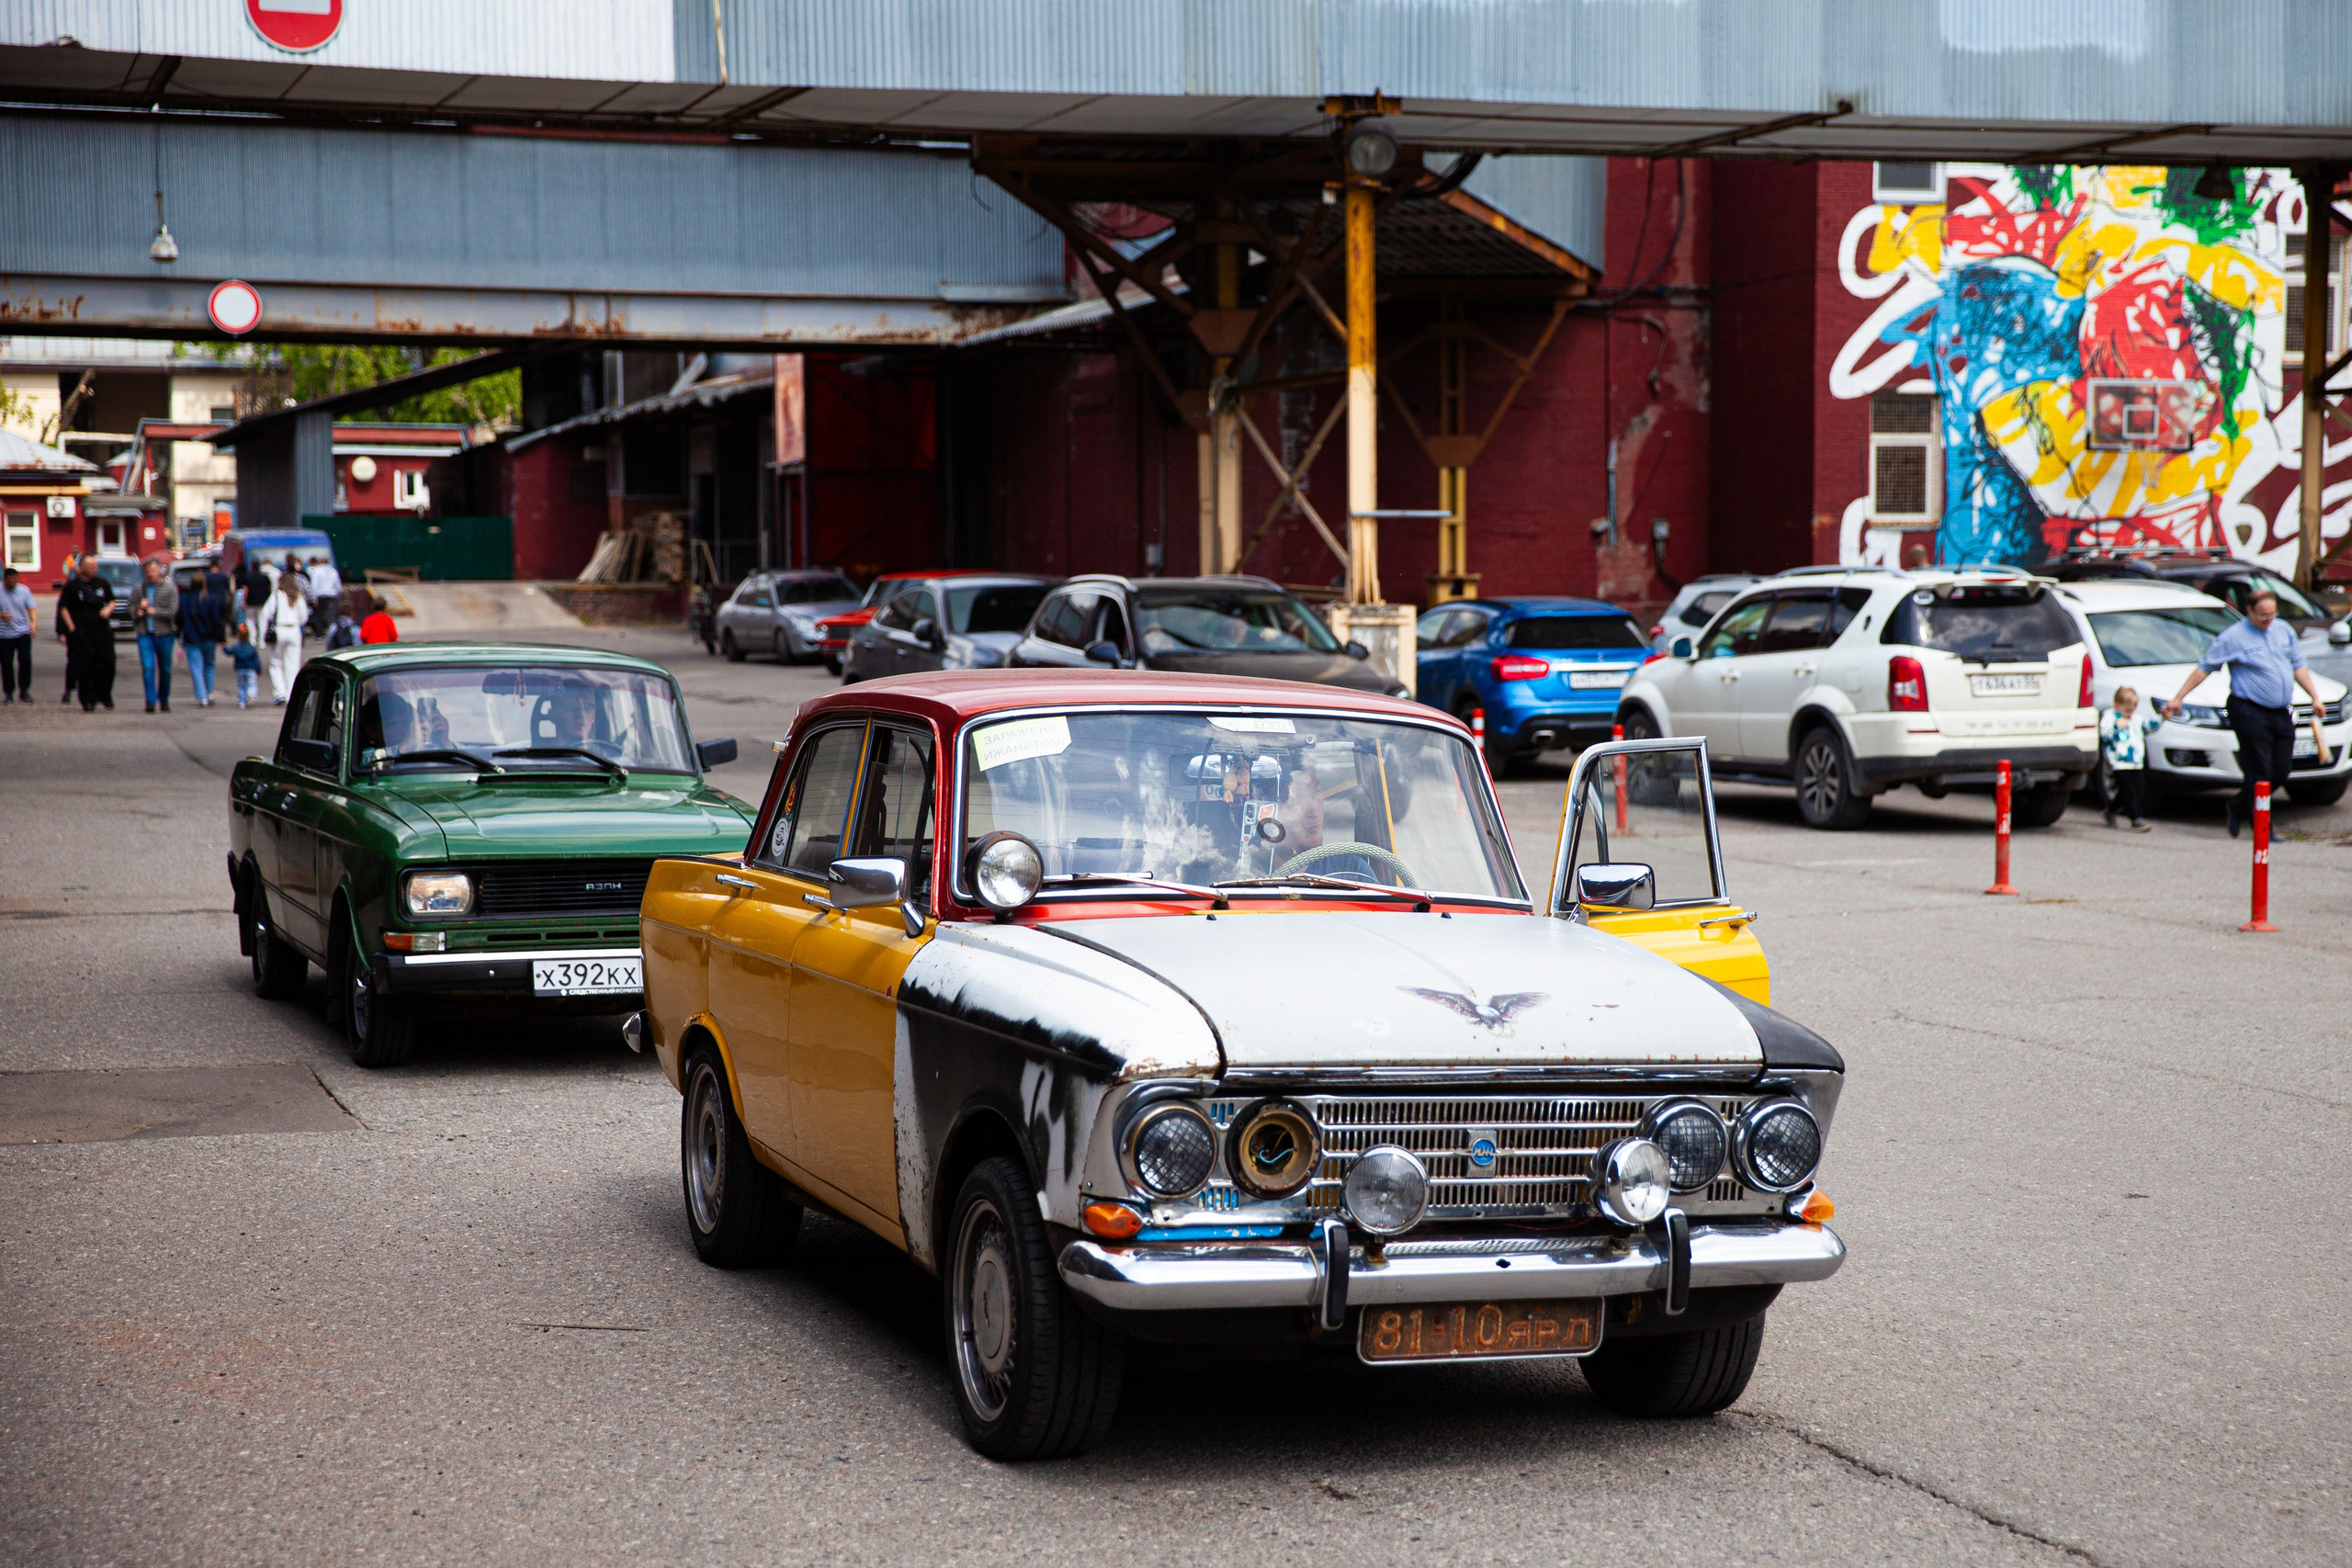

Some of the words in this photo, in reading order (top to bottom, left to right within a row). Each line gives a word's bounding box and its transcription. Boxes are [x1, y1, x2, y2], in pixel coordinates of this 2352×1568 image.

[984, 725, 1058, 745] ЗАРАЖЕНО
[1255, 721, 1283, 729] TAXI
[983, 737, 1066, 761] ИЖАНИТОМ!
[541, 963, 637, 987] Х392КХ
